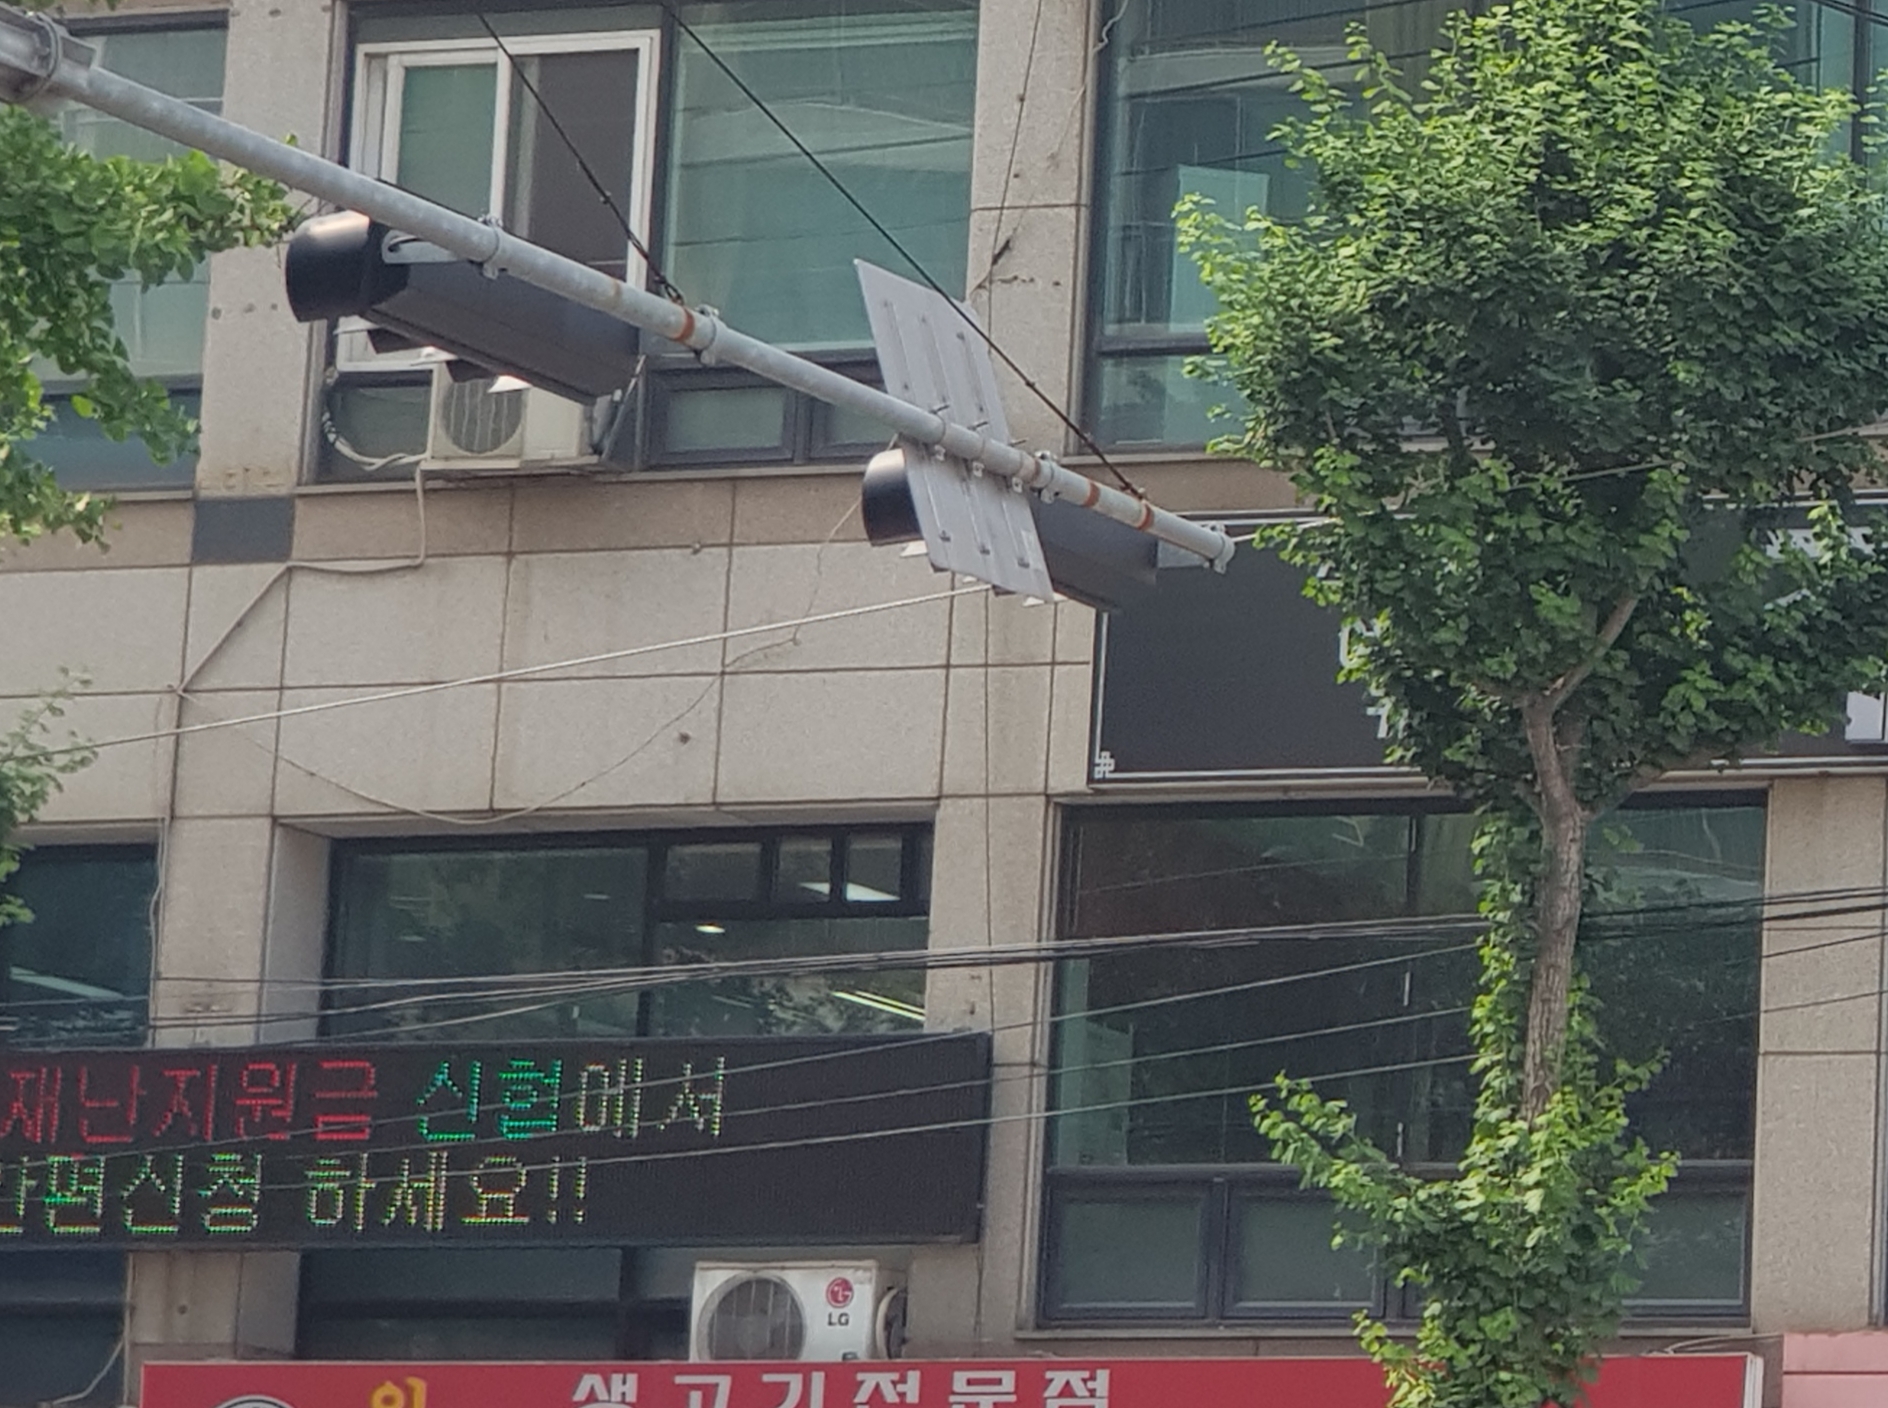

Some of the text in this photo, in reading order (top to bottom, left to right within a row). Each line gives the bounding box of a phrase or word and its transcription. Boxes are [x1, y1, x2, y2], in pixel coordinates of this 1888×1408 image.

[0, 1059, 378, 1144] 재난지원금
[303, 1150, 588, 1233] 하세요!!
[827, 1312, 850, 1327] LG
